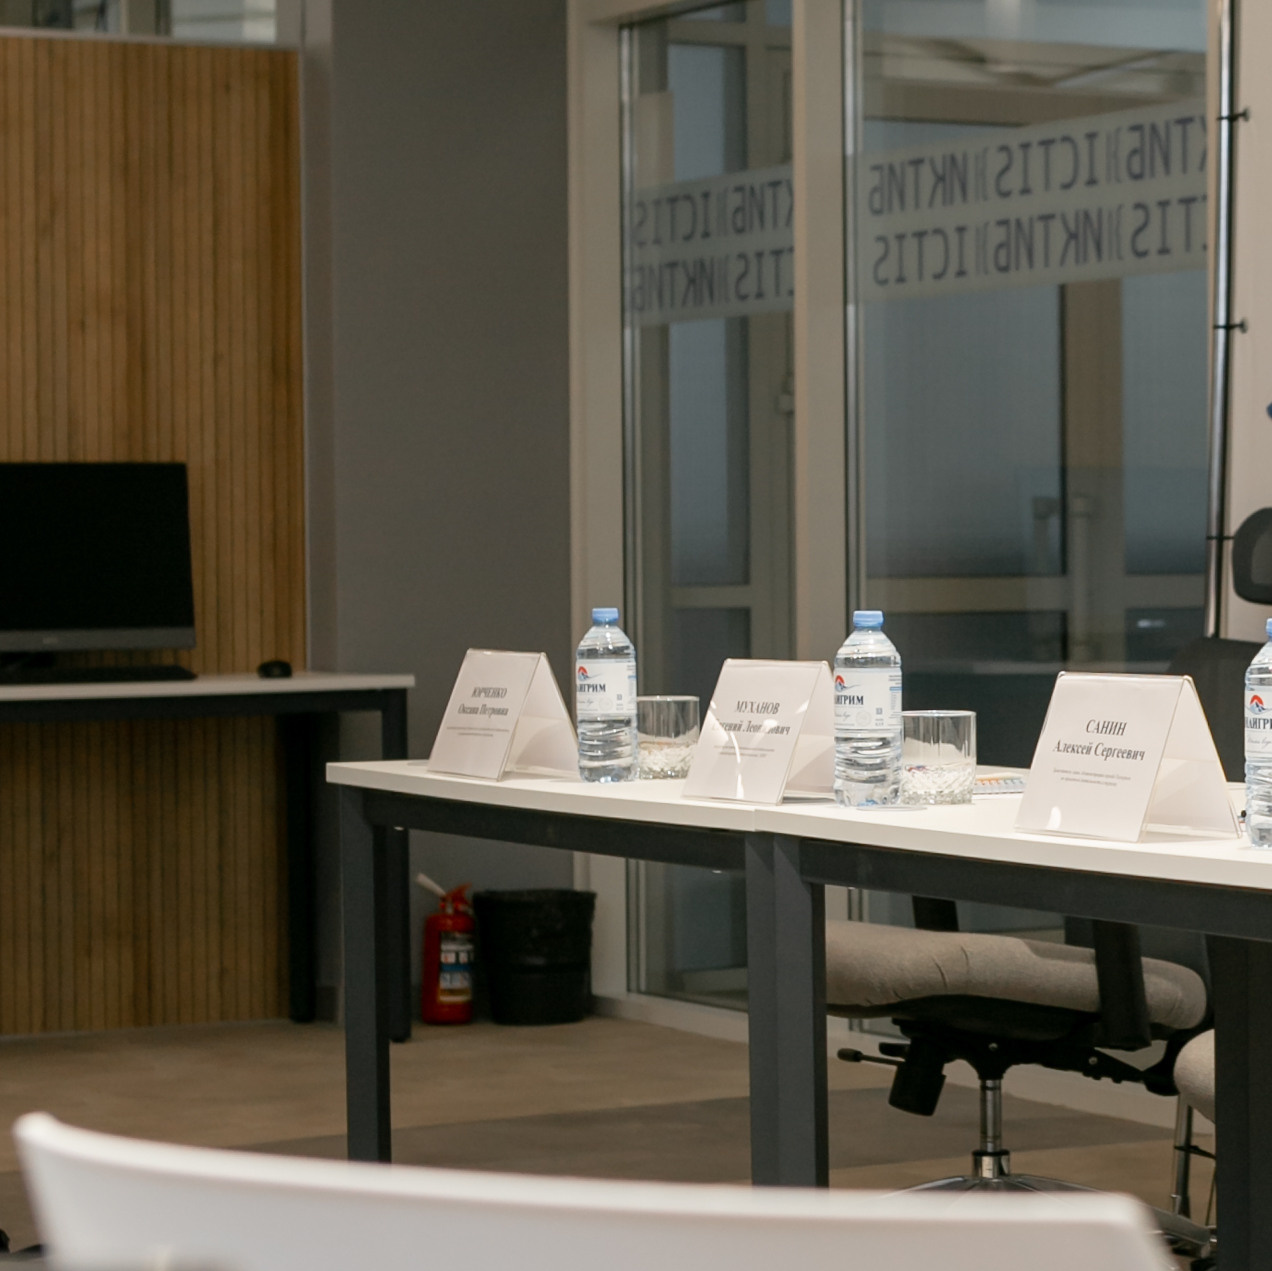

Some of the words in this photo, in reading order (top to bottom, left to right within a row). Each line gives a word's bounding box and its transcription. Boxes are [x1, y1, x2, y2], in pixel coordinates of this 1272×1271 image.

[735, 700, 780, 715] МУХАНОВ
[1086, 719, 1127, 736] САНИН
[1053, 739, 1093, 756] Алексей
[1094, 742, 1145, 762] Сергеевич
